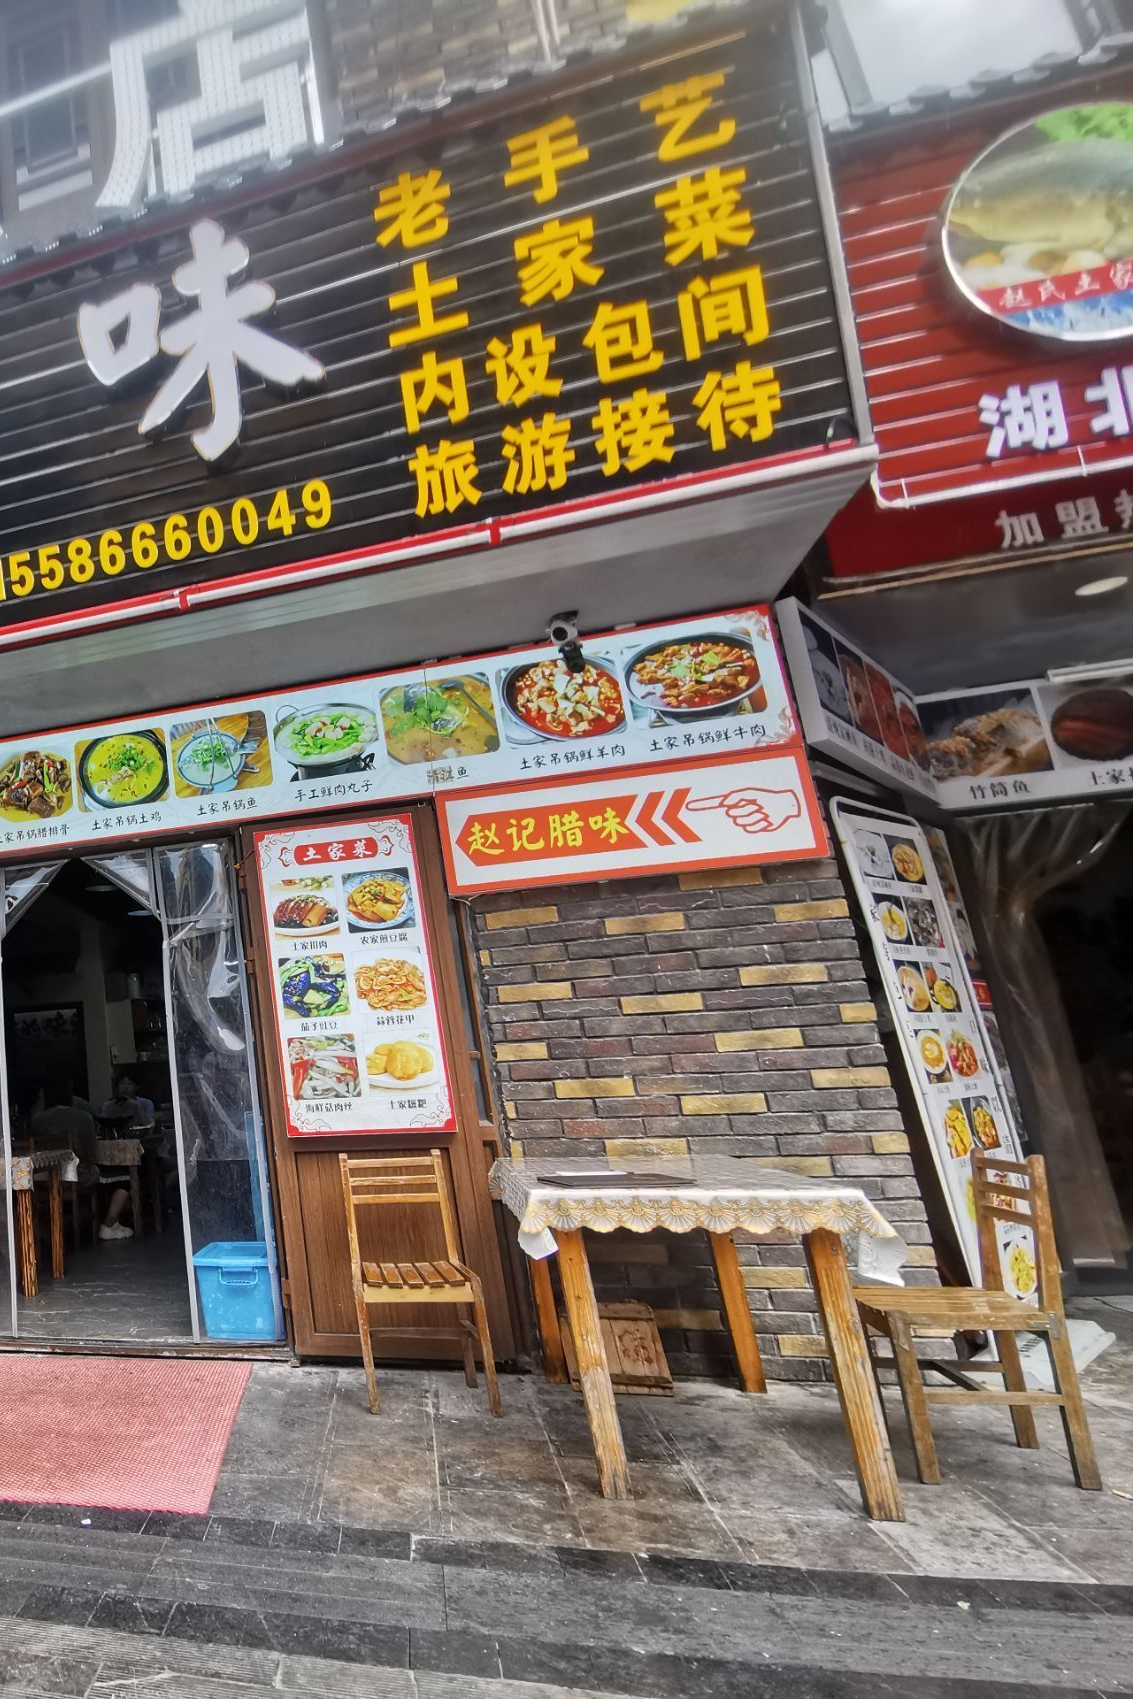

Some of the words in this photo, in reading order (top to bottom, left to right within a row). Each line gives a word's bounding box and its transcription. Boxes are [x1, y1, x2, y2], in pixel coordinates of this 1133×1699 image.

[374, 71, 736, 248] 老手艺
[388, 167, 755, 348] 土家菜
[400, 265, 769, 433] 内设包间
[409, 361, 782, 517] 旅游接待
[650, 723, 766, 753] 土家吊锅鲜牛肉
[520, 744, 626, 770] 土家吊锅鲜羊肉
[1091, 766, 1133, 787] 土家
[295, 781, 373, 802] 手工鲜肉丸子
[197, 797, 258, 817] 土家吊锅鱼
[92, 811, 162, 831] 土家吊锅土鸡
[468, 807, 630, 856] 赵记腊味
[303, 840, 372, 862] 土家菜
[292, 939, 328, 952] 土家扣肉
